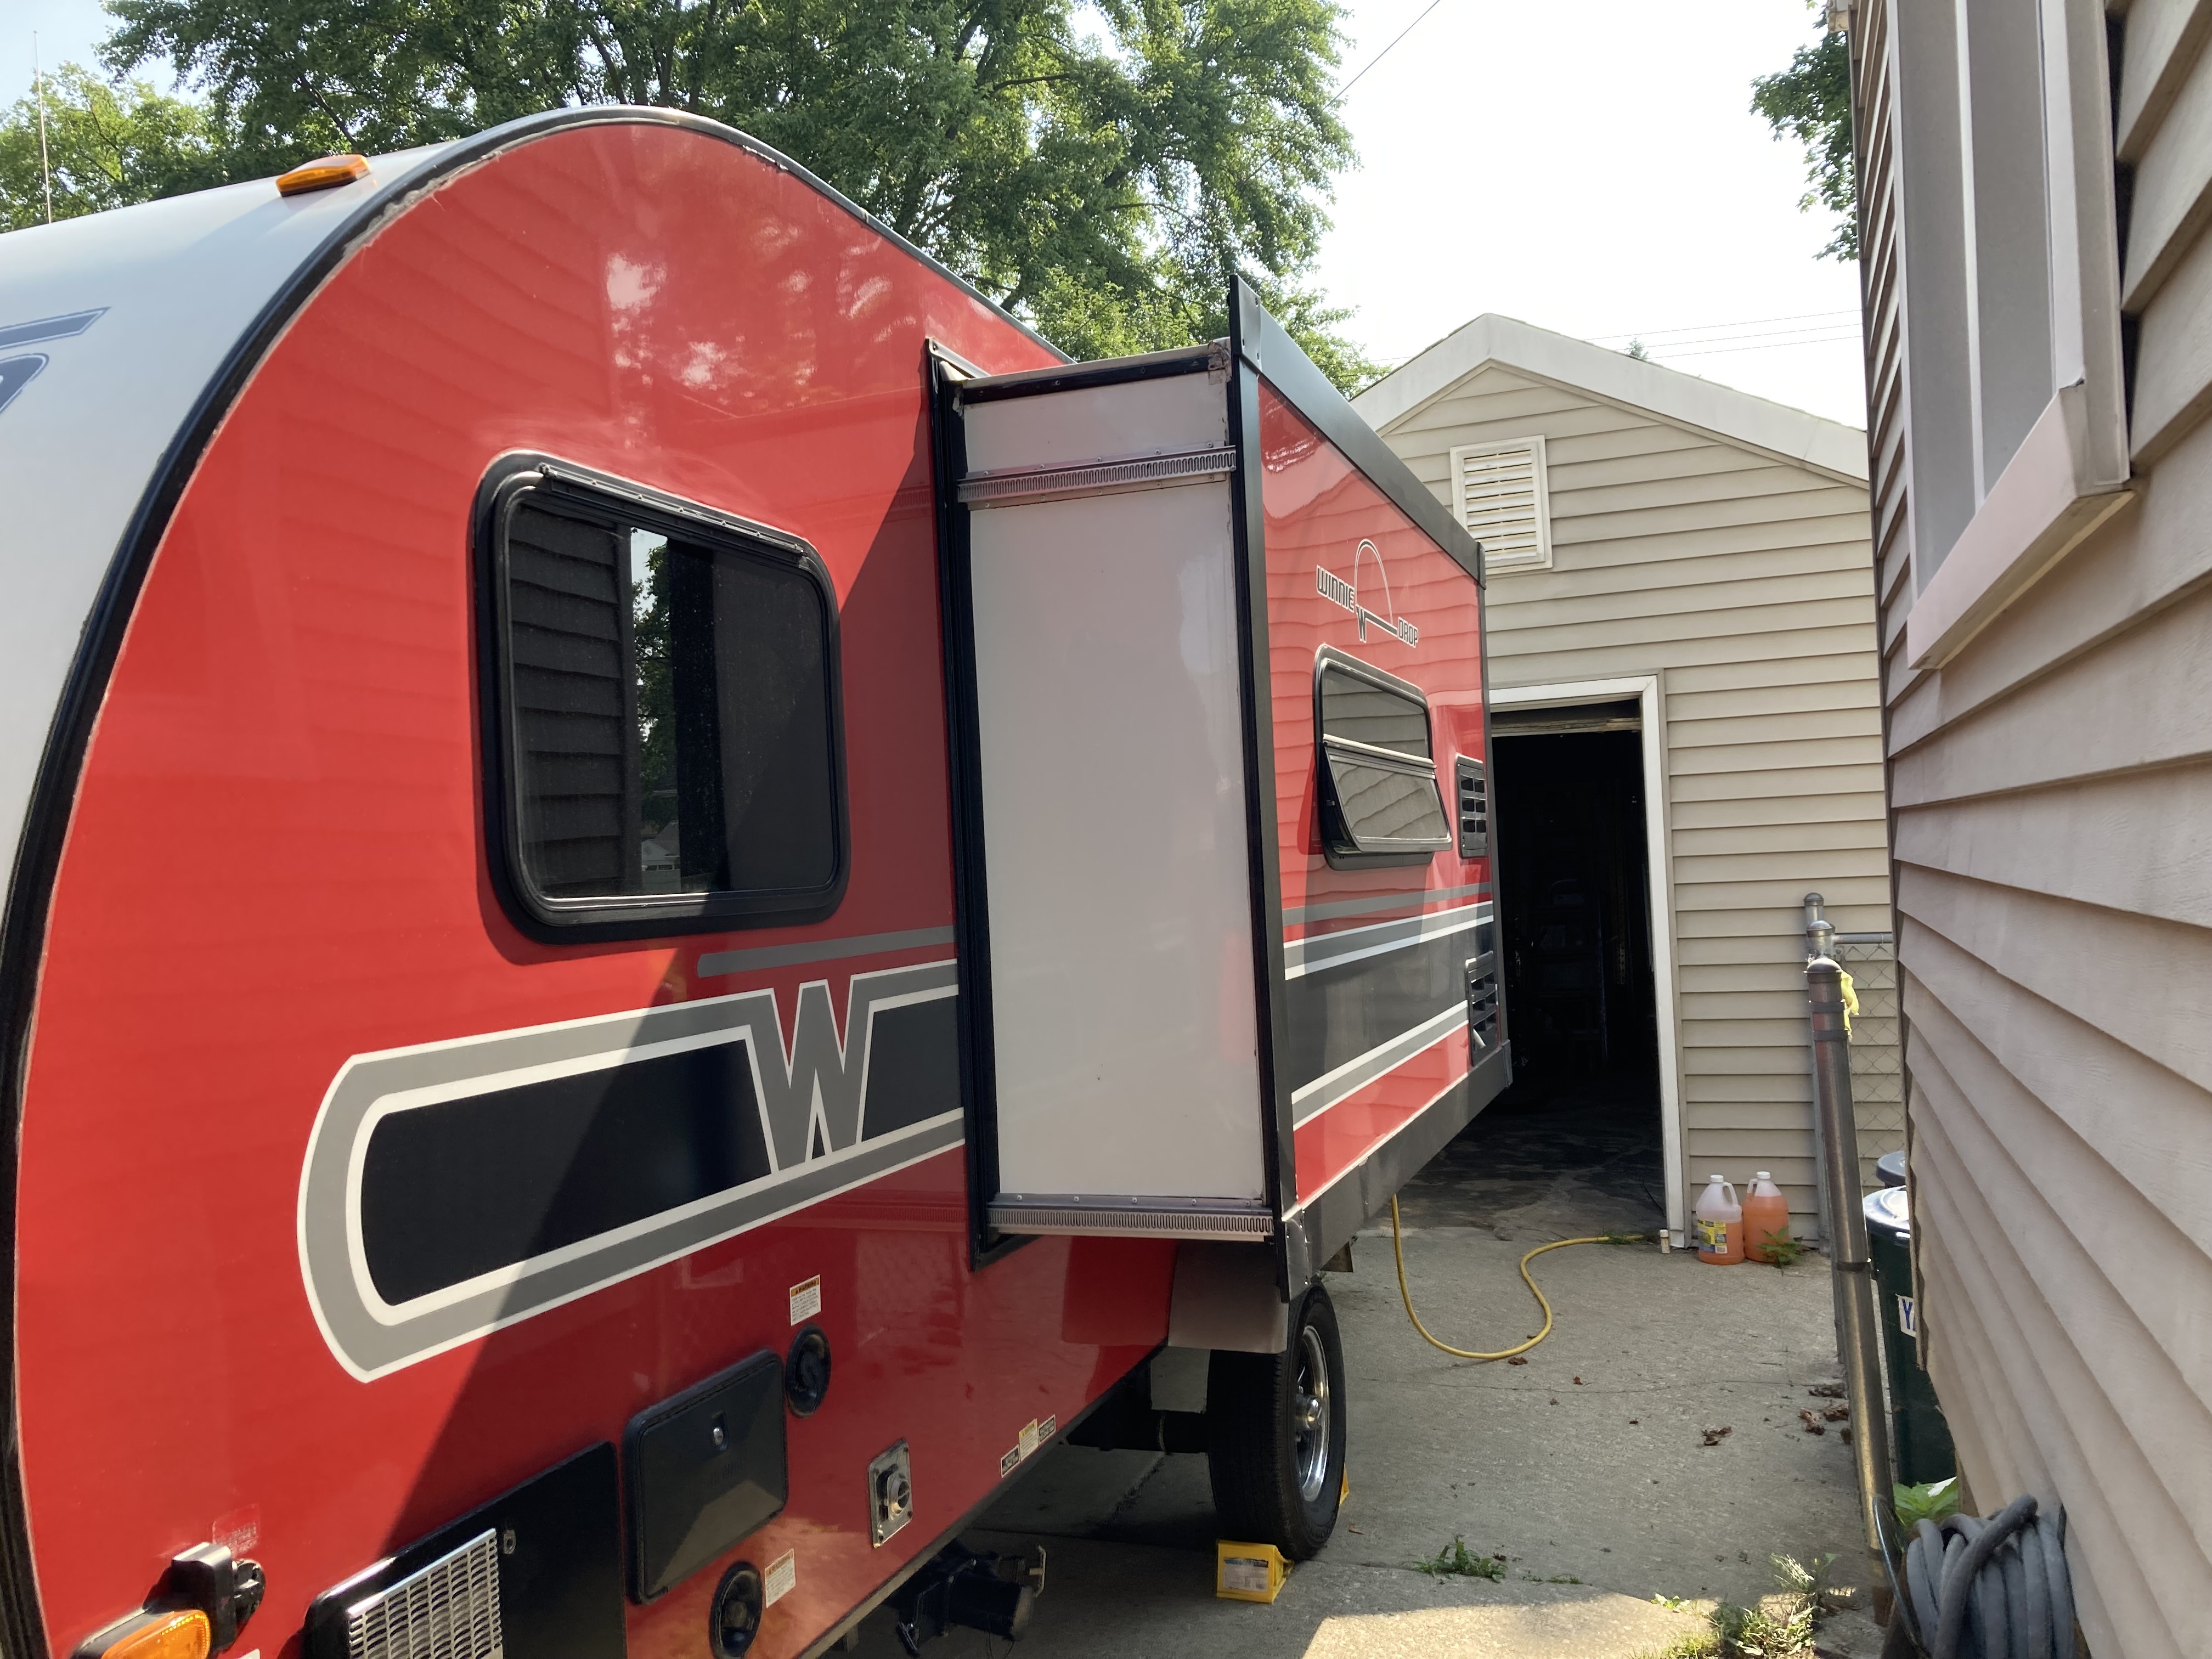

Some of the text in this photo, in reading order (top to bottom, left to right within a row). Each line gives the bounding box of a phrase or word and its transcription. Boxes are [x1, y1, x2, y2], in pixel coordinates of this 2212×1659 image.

[1317, 565, 1355, 613] WINNIE
[1398, 616, 1419, 648] DROP
[747, 975, 873, 1173] W
[1902, 1299, 1915, 1330] Y
